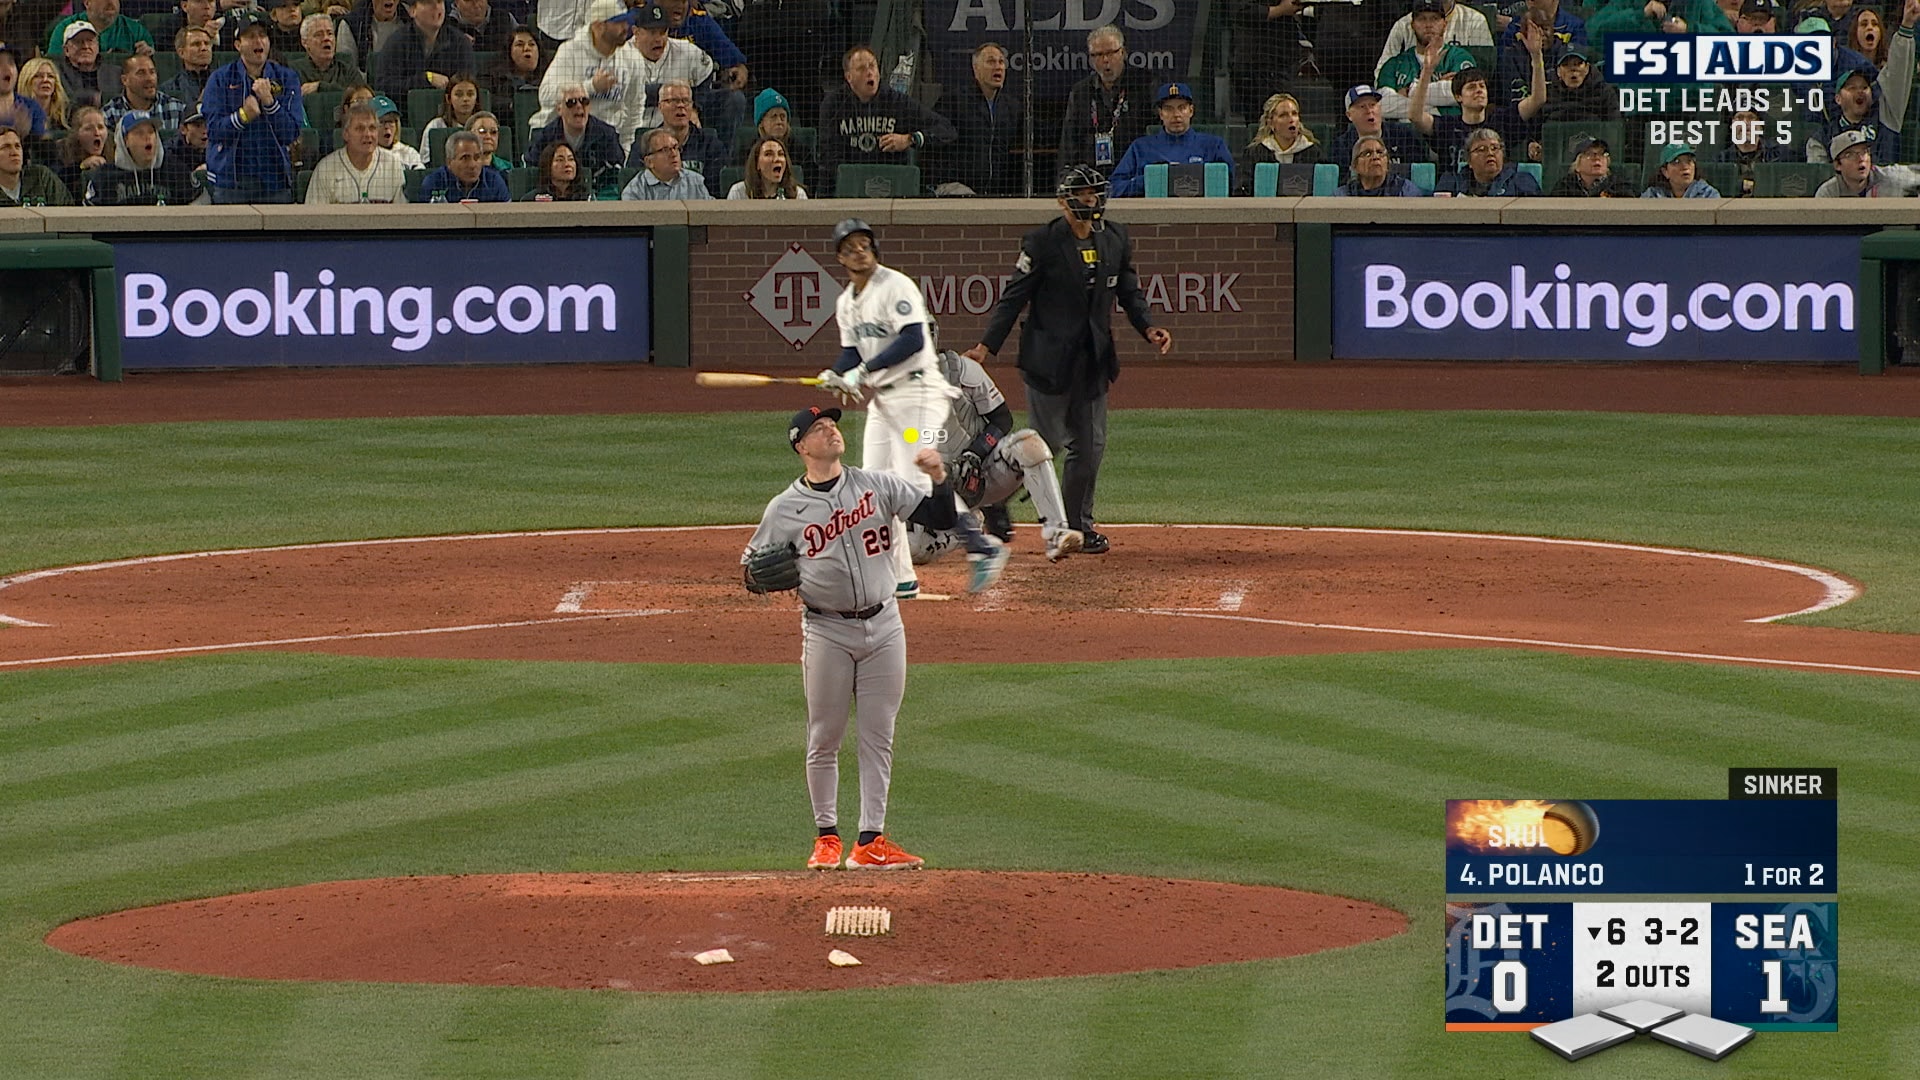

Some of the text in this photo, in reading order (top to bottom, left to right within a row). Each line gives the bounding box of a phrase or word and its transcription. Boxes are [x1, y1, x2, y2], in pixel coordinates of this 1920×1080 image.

[948, 0, 1176, 31] ALDS
[840, 116, 896, 136] MARINERS
[125, 269, 617, 352] Booking.com
[1115, 272, 1243, 312] ARK
[1365, 263, 1854, 347] Booking.com
[804, 490, 876, 558] Detroit
[862, 525, 892, 557] 29
